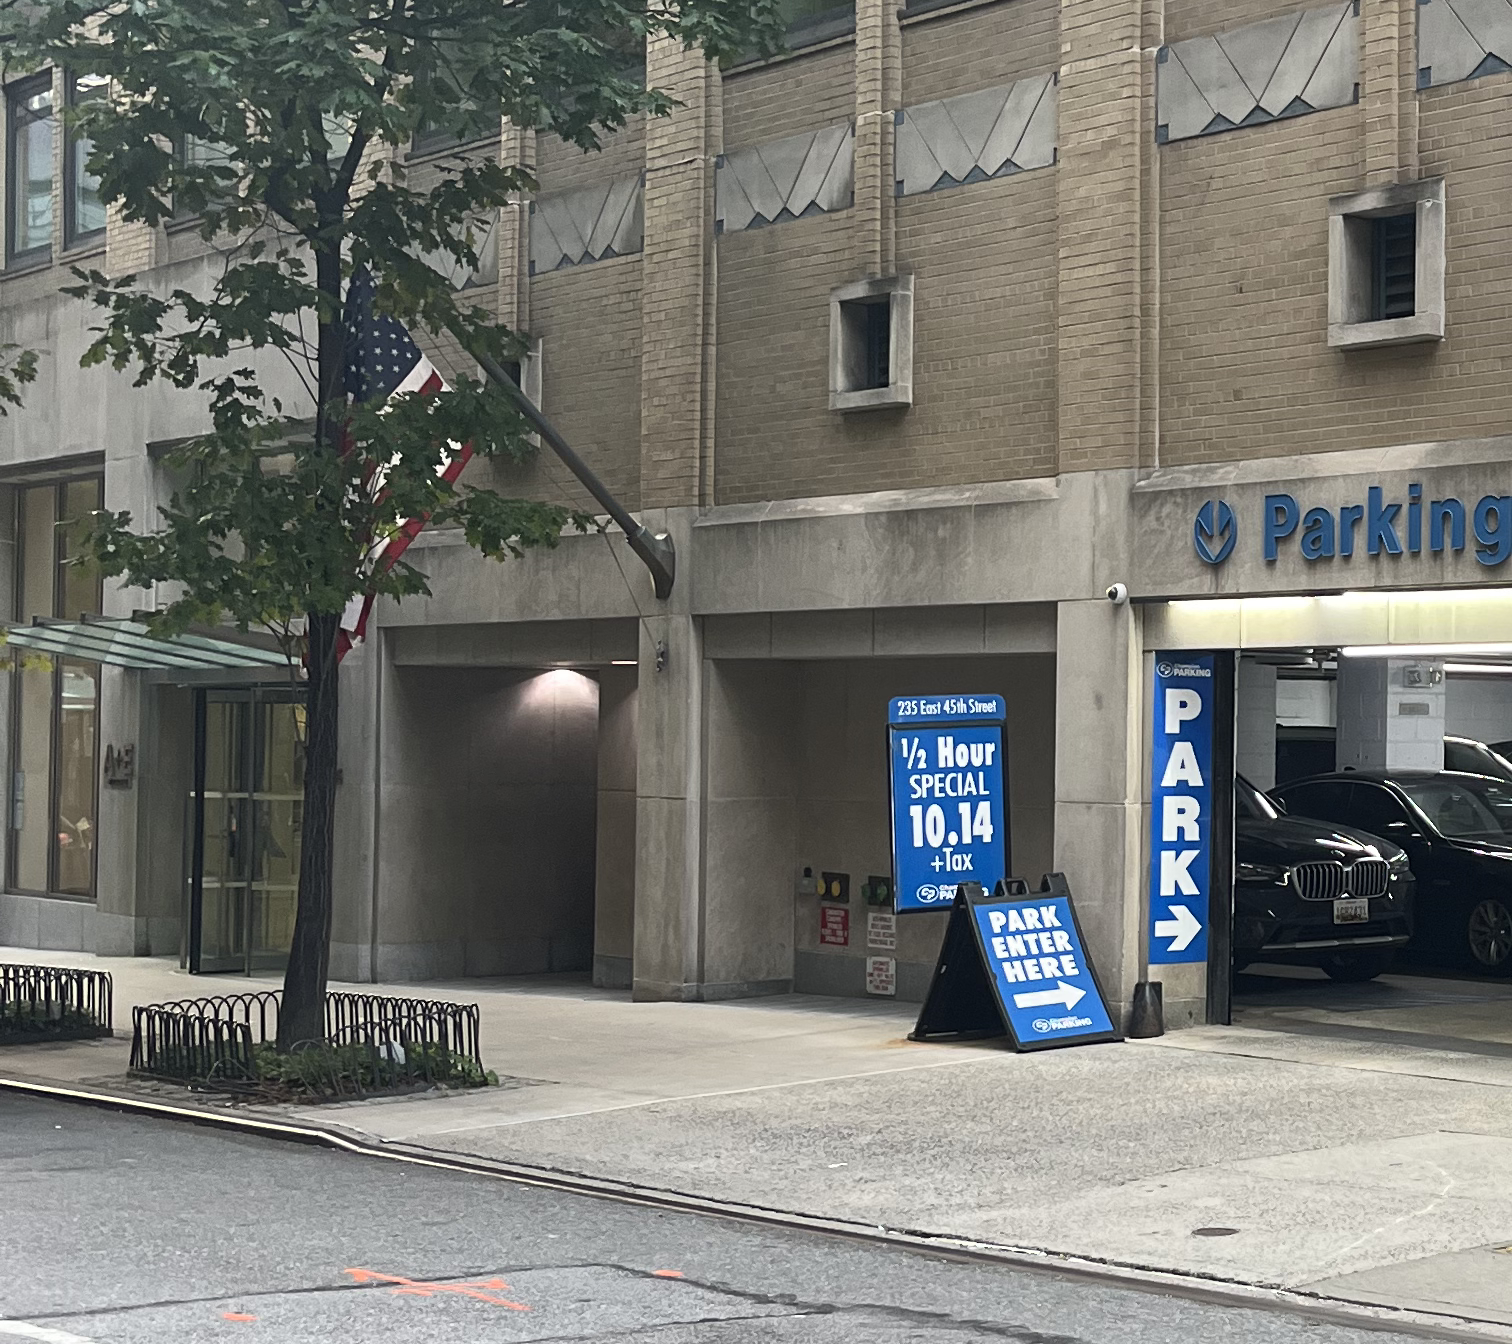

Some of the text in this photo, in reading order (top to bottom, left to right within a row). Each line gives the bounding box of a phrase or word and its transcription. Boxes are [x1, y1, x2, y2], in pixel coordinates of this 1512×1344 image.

[1174, 669, 1211, 677] PARKING
[898, 698, 996, 715] 235 East 45th Street
[938, 736, 995, 768] Hour
[909, 772, 989, 798] SPECIAL
[1160, 688, 1204, 896] PARK
[910, 801, 993, 848] 10.14
[930, 847, 973, 872] +Tax
[988, 905, 1062, 934] PARK
[991, 930, 1074, 959] ENTER
[1001, 954, 1080, 983] HERE
